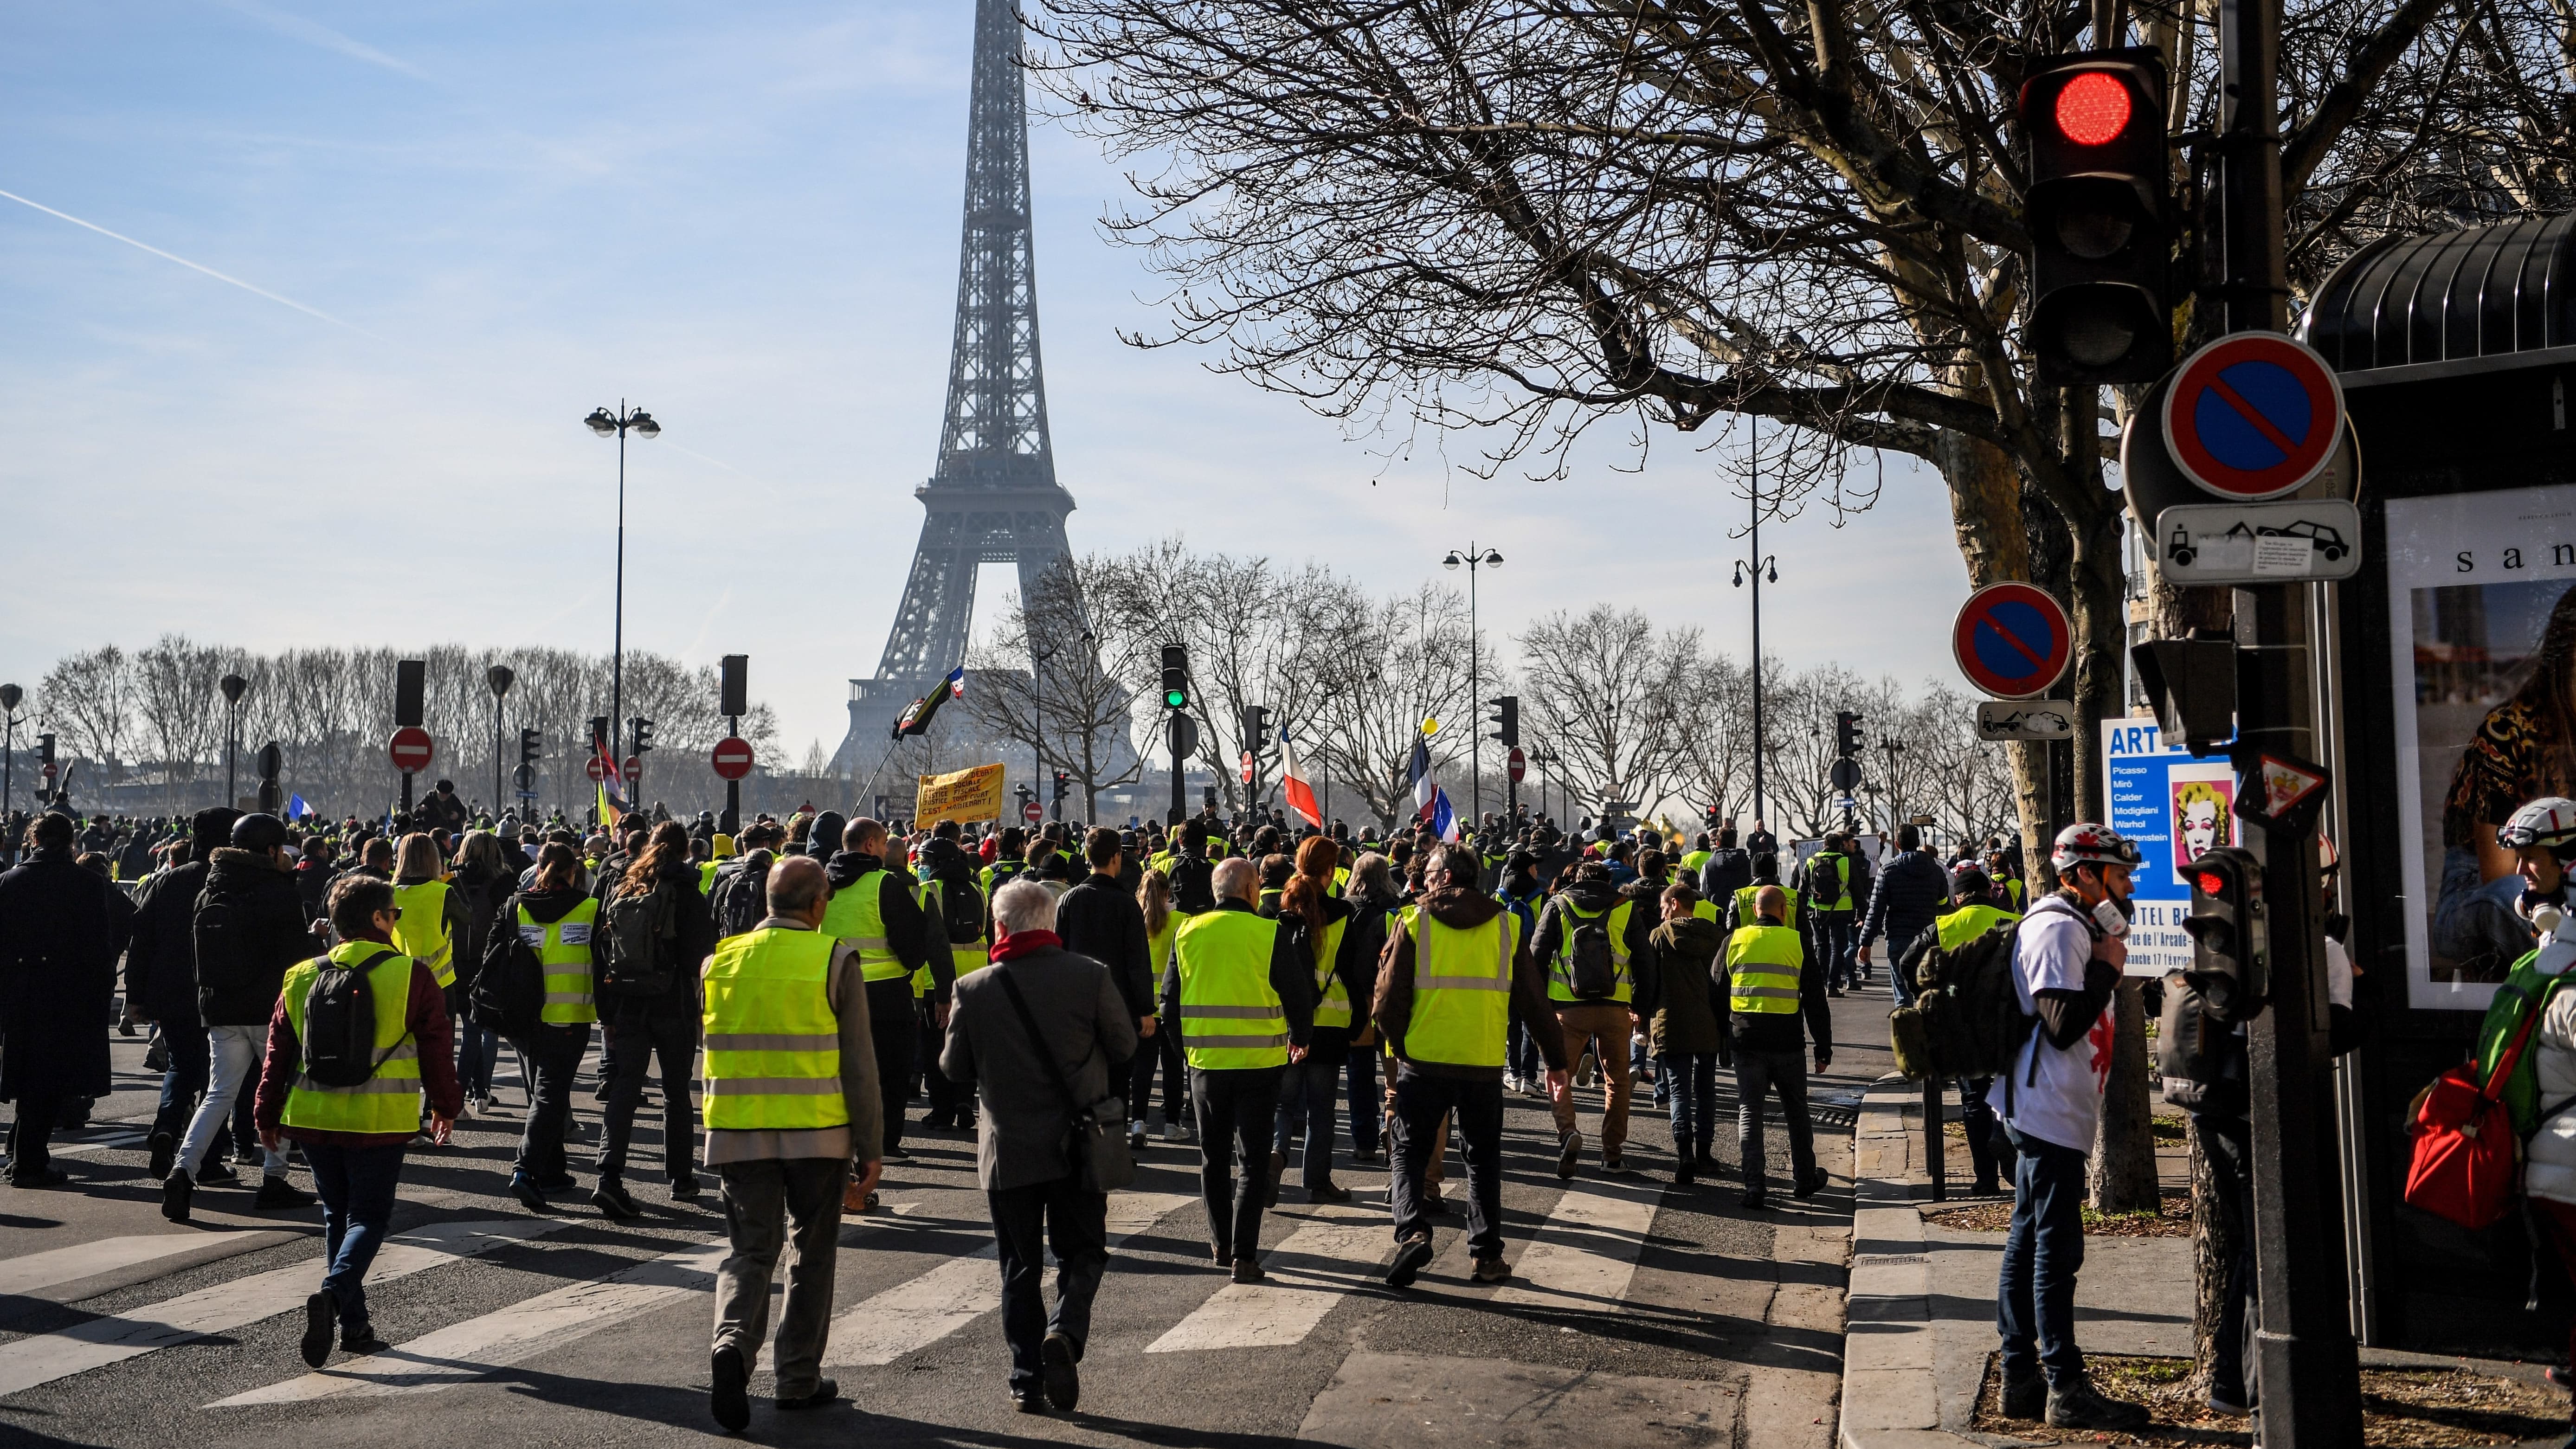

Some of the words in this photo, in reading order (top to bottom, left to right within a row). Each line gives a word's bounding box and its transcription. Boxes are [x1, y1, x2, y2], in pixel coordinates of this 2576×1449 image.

[2110, 726, 2158, 755] ART
[971, 768, 994, 778] DÉBAT
[953, 779, 981, 789] SOCIALE
[924, 791, 947, 799] JUSTICE
[953, 786, 980, 795] FISCALE
[922, 807, 941, 815] C'EST
[946, 799, 986, 811] MAINTENANT
[2114, 806, 2158, 816] Modigliani
[2143, 932, 2151, 946] de
[2153, 953, 2161, 965] 17
